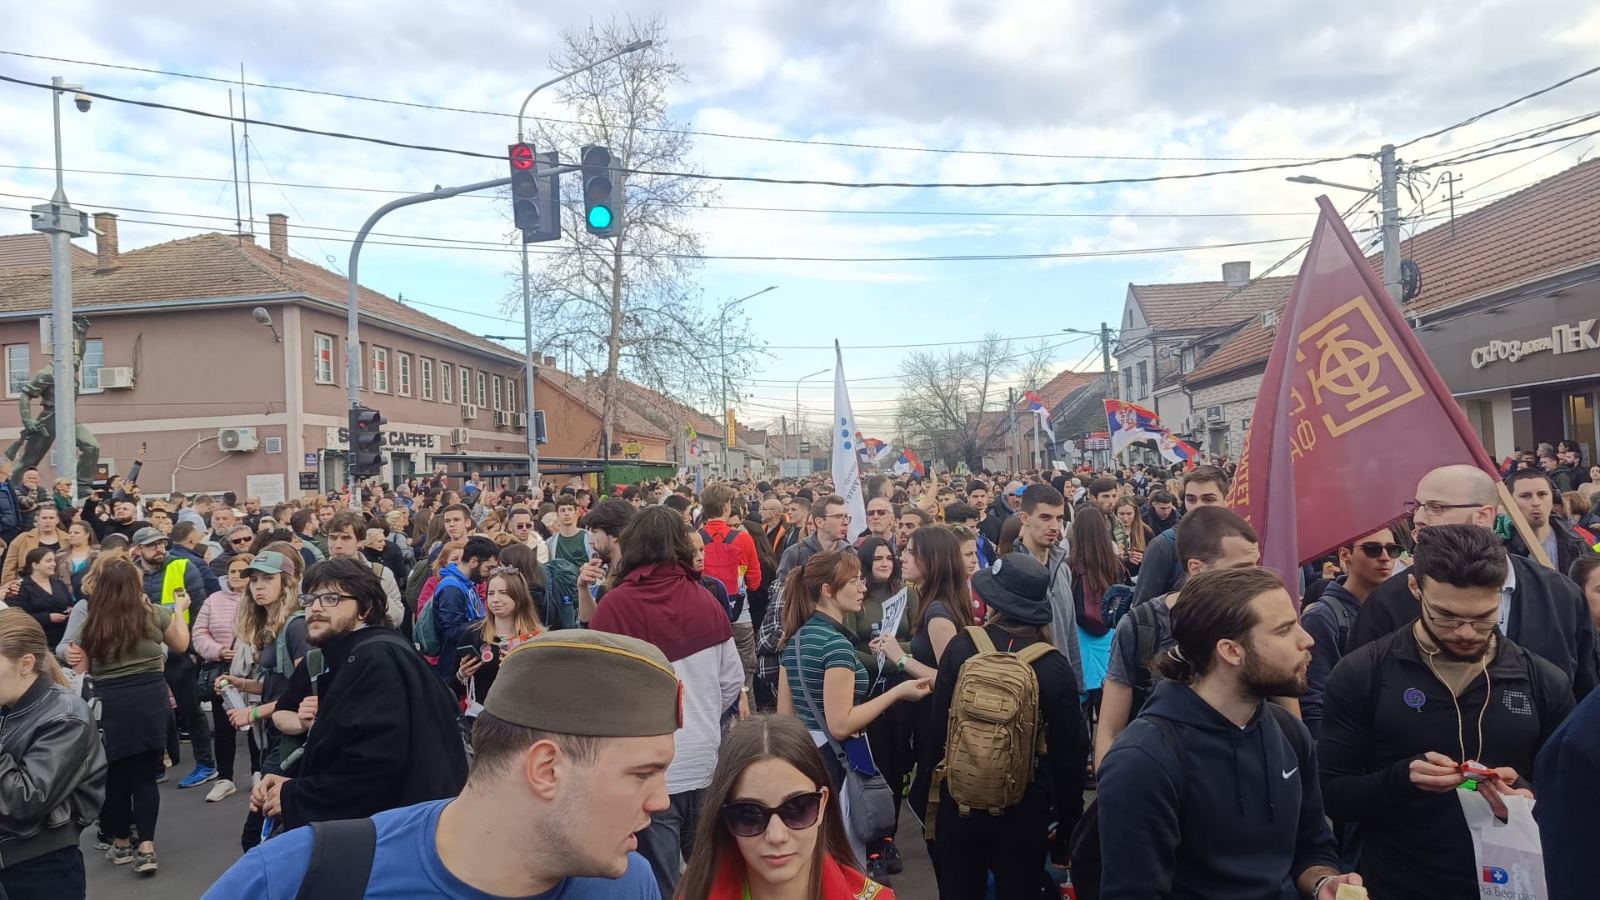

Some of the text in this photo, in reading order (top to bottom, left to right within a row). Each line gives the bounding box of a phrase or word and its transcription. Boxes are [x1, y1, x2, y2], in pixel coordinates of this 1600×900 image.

[1471, 340, 1521, 369] СКРОЗ
[1552, 318, 1600, 355] ПЕК
[389, 431, 434, 448] CAFFEE
